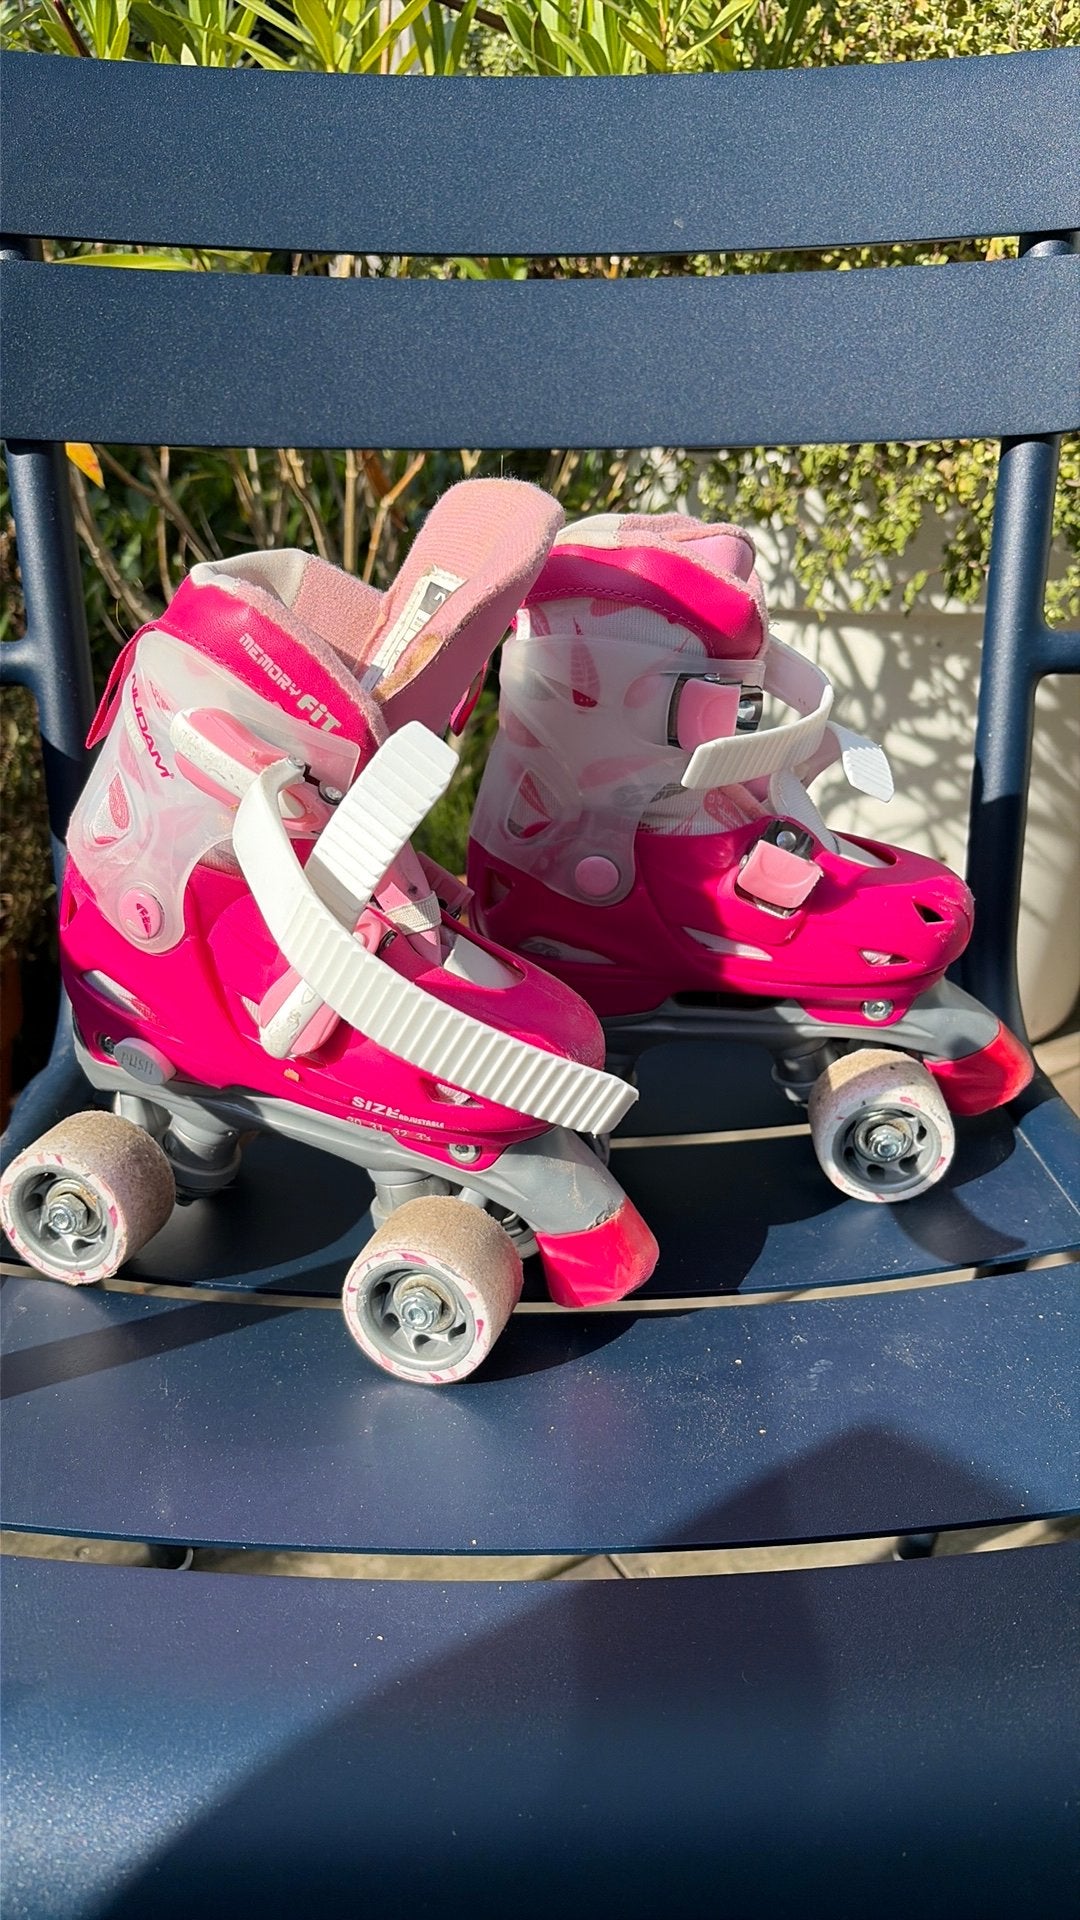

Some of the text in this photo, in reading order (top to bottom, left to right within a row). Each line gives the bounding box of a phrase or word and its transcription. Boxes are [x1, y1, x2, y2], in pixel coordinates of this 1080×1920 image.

[238, 633, 301, 696] MEMORY
[351, 1095, 445, 1129] SIZE ADJUSTABLE
[391, 1127, 408, 1139] 32
